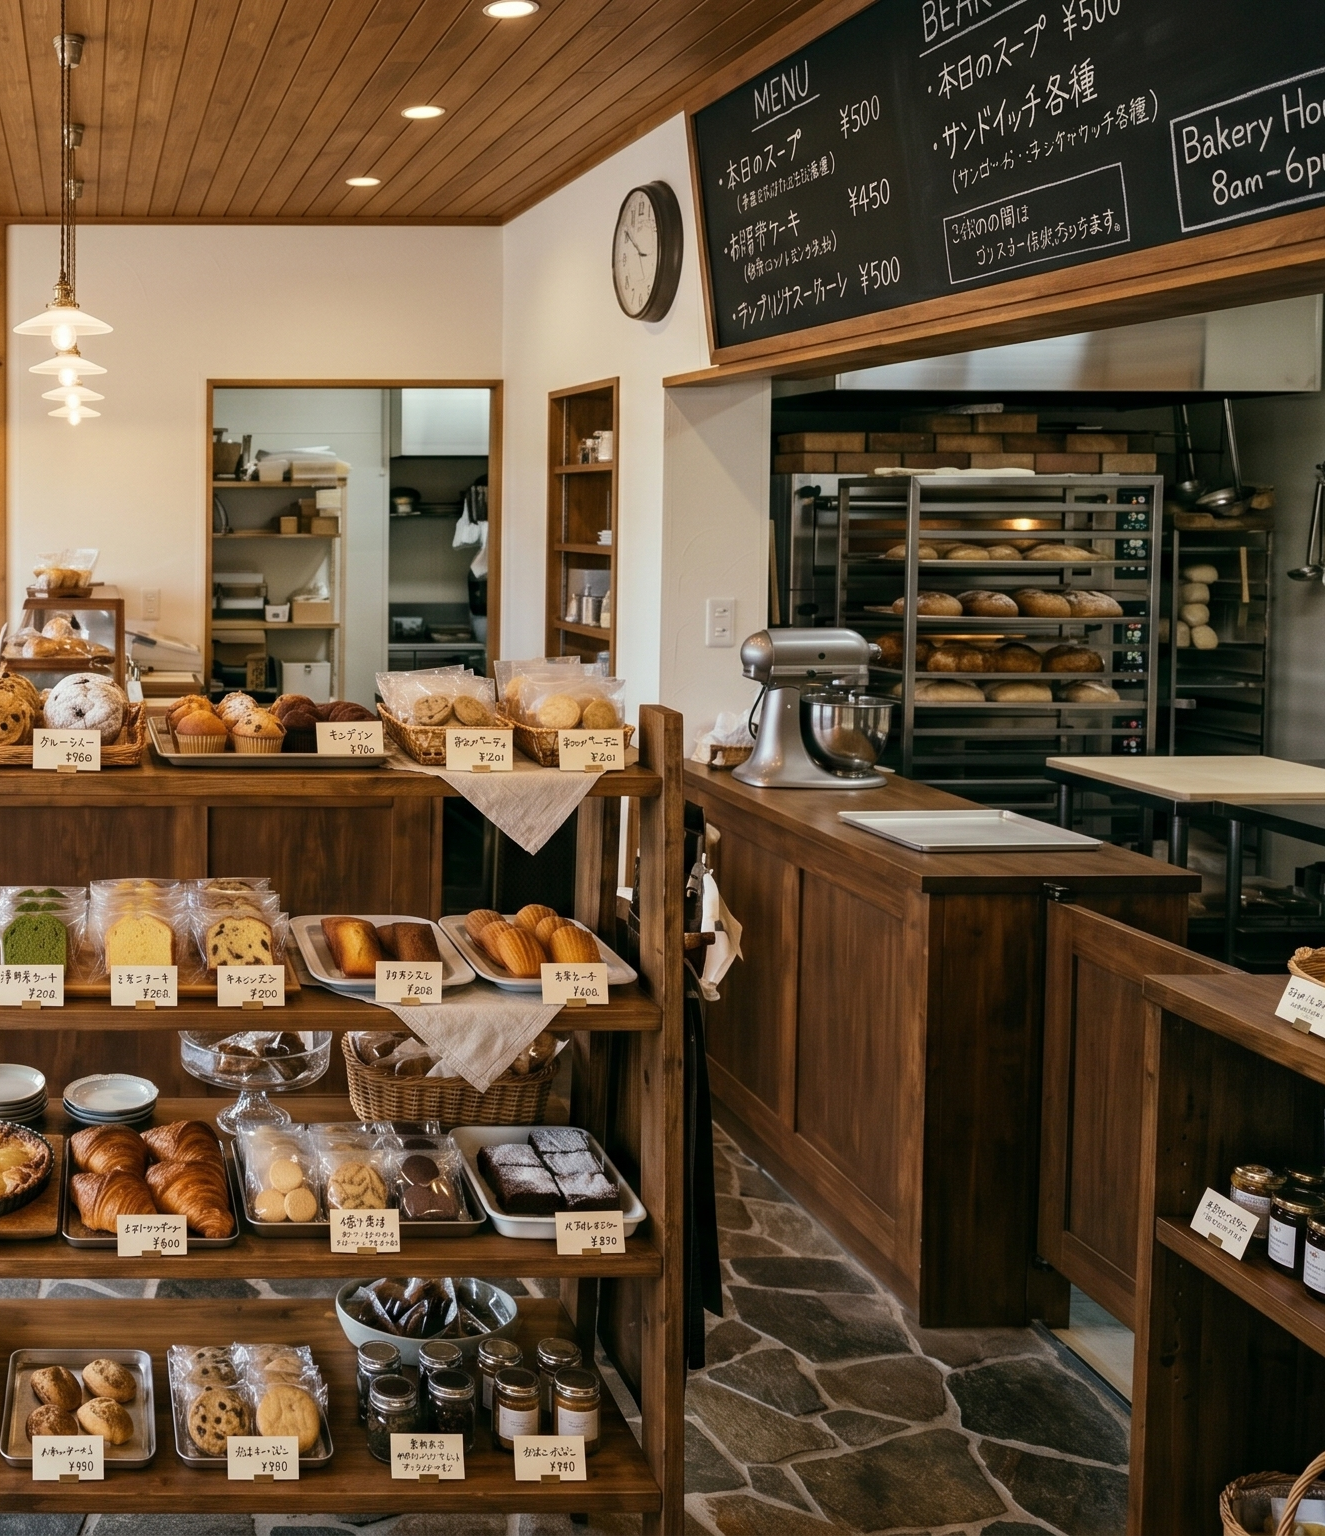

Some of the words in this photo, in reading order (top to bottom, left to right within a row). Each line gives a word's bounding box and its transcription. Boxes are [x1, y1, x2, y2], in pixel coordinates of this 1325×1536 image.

[753, 59, 810, 120] MENU
[839, 94, 881, 140] ¥500
[1182, 115, 1273, 165] Bakery
[1281, 87, 1325, 134] Ho
[847, 177, 891, 217] ¥450
[1211, 146, 1325, 206] 8am-6p
[858, 256, 902, 296] ¥500
